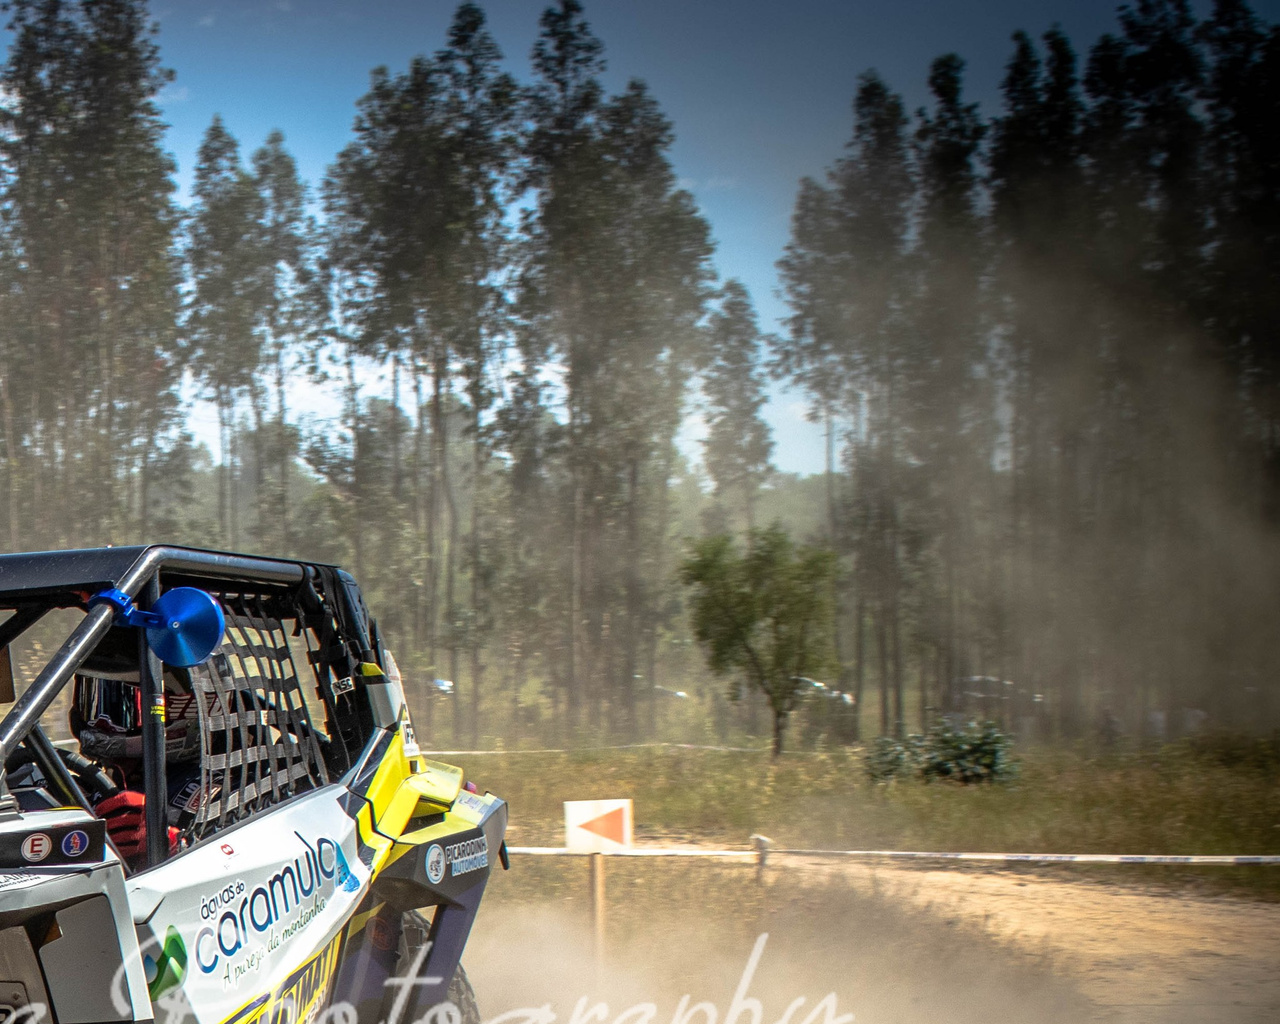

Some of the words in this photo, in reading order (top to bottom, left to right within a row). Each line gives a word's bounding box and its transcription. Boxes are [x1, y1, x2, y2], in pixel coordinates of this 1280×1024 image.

[29, 837, 44, 854] E
[195, 831, 336, 974] caramulo
[200, 884, 236, 921] águas
[235, 882, 245, 895] do
[222, 962, 233, 989] A
[233, 946, 265, 985] pureza
[267, 929, 280, 954] da
[282, 892, 327, 943] montanha
